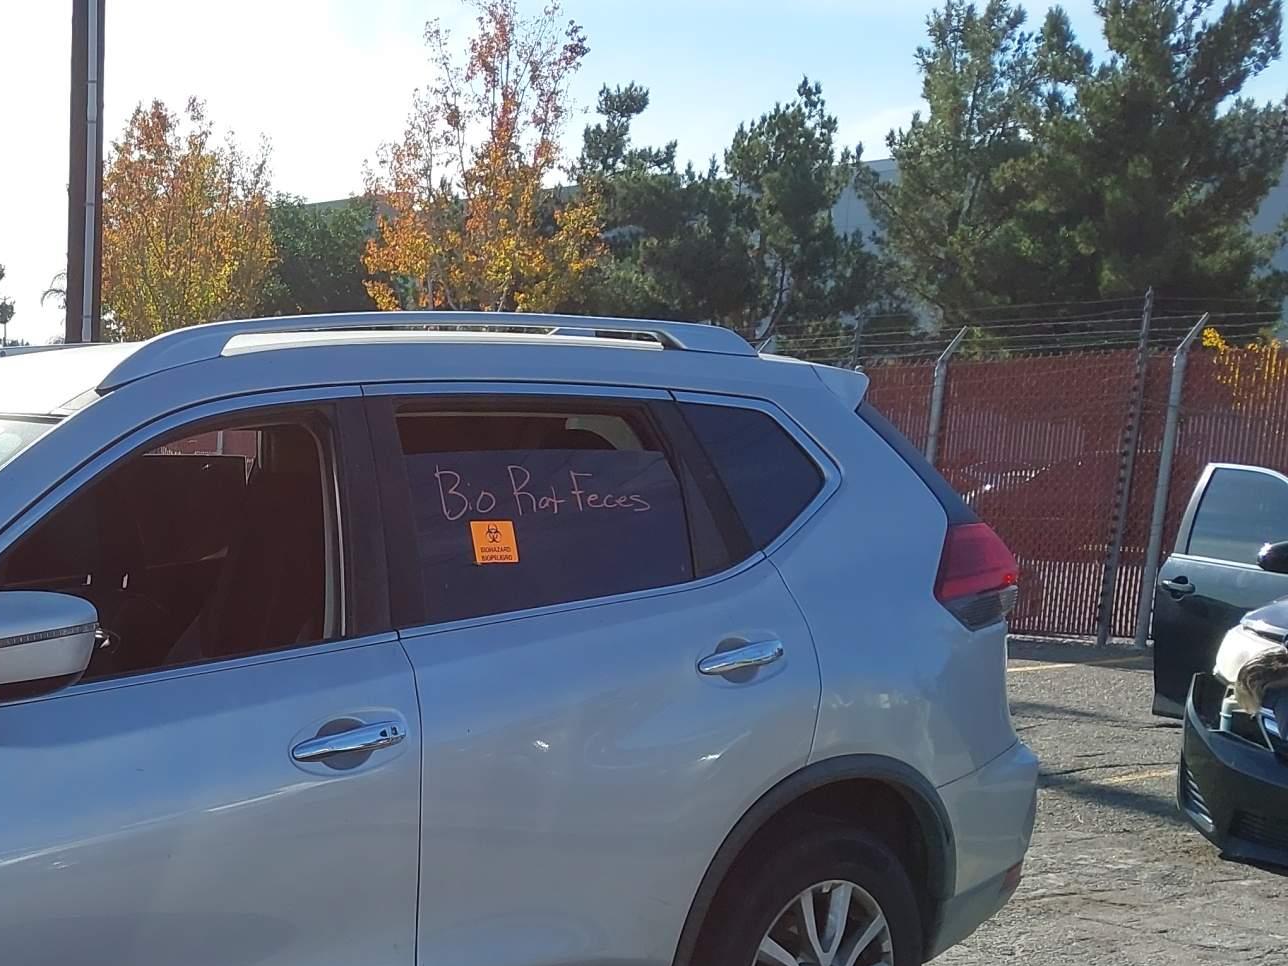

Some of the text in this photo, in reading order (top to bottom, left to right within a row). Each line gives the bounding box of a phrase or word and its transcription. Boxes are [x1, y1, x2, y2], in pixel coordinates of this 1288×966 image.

[435, 465, 650, 520] Bio Rat Feces
